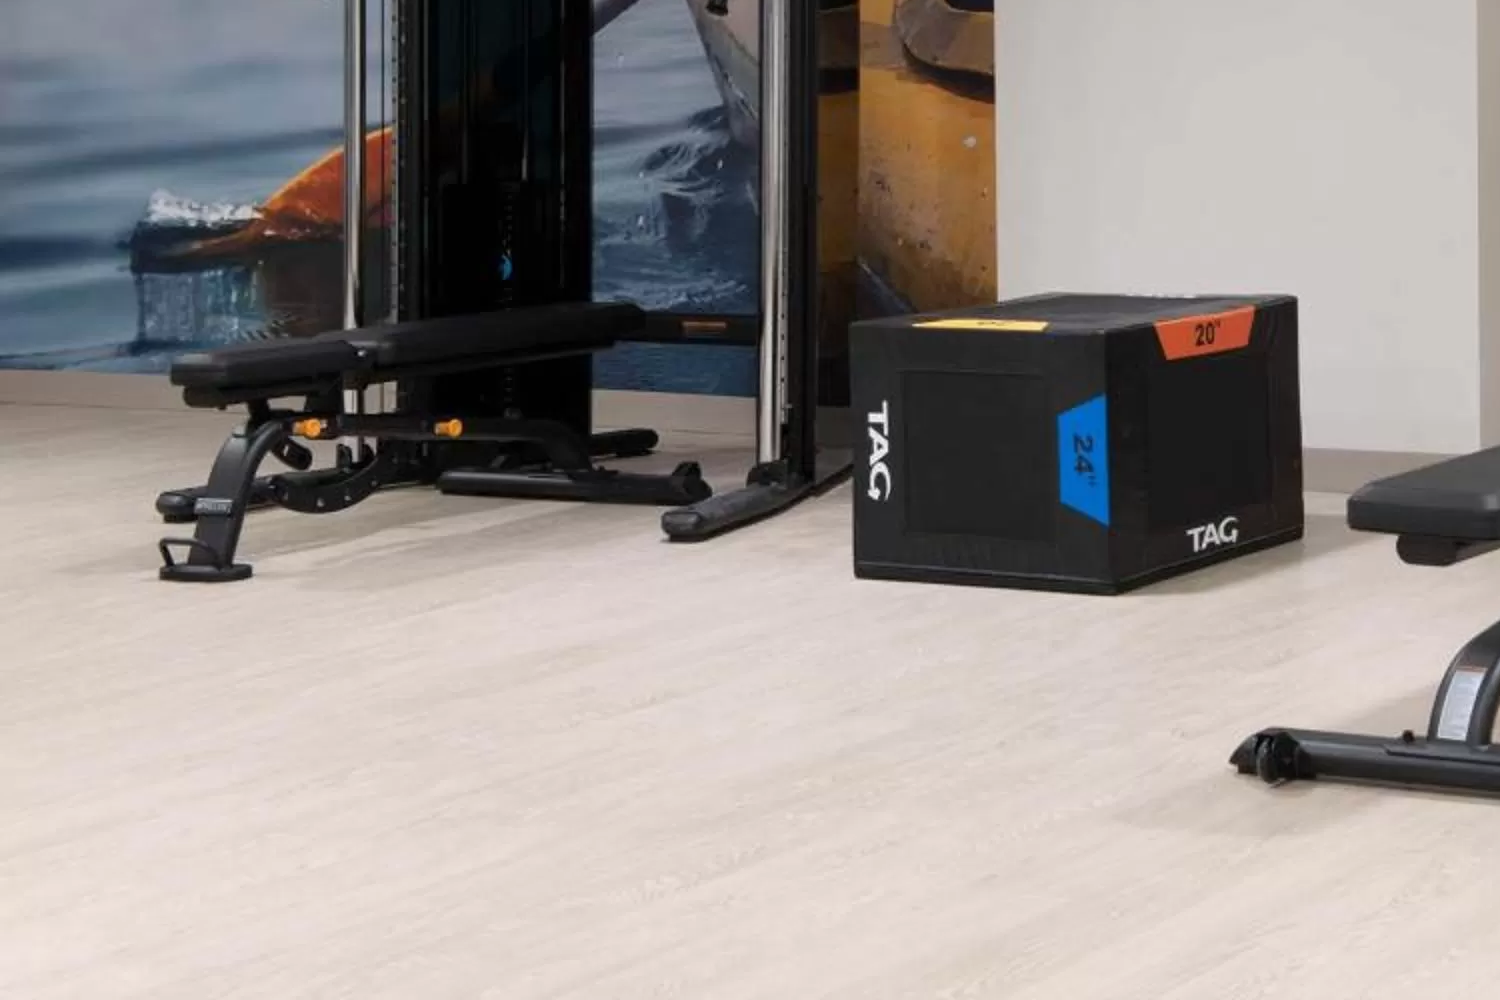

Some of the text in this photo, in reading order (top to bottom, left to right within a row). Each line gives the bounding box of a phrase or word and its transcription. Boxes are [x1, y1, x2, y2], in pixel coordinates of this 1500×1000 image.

[1194, 320, 1221, 347] 20"
[867, 400, 891, 501] TAG
[1072, 433, 1097, 487] 24"
[1186, 516, 1238, 553] TAG
